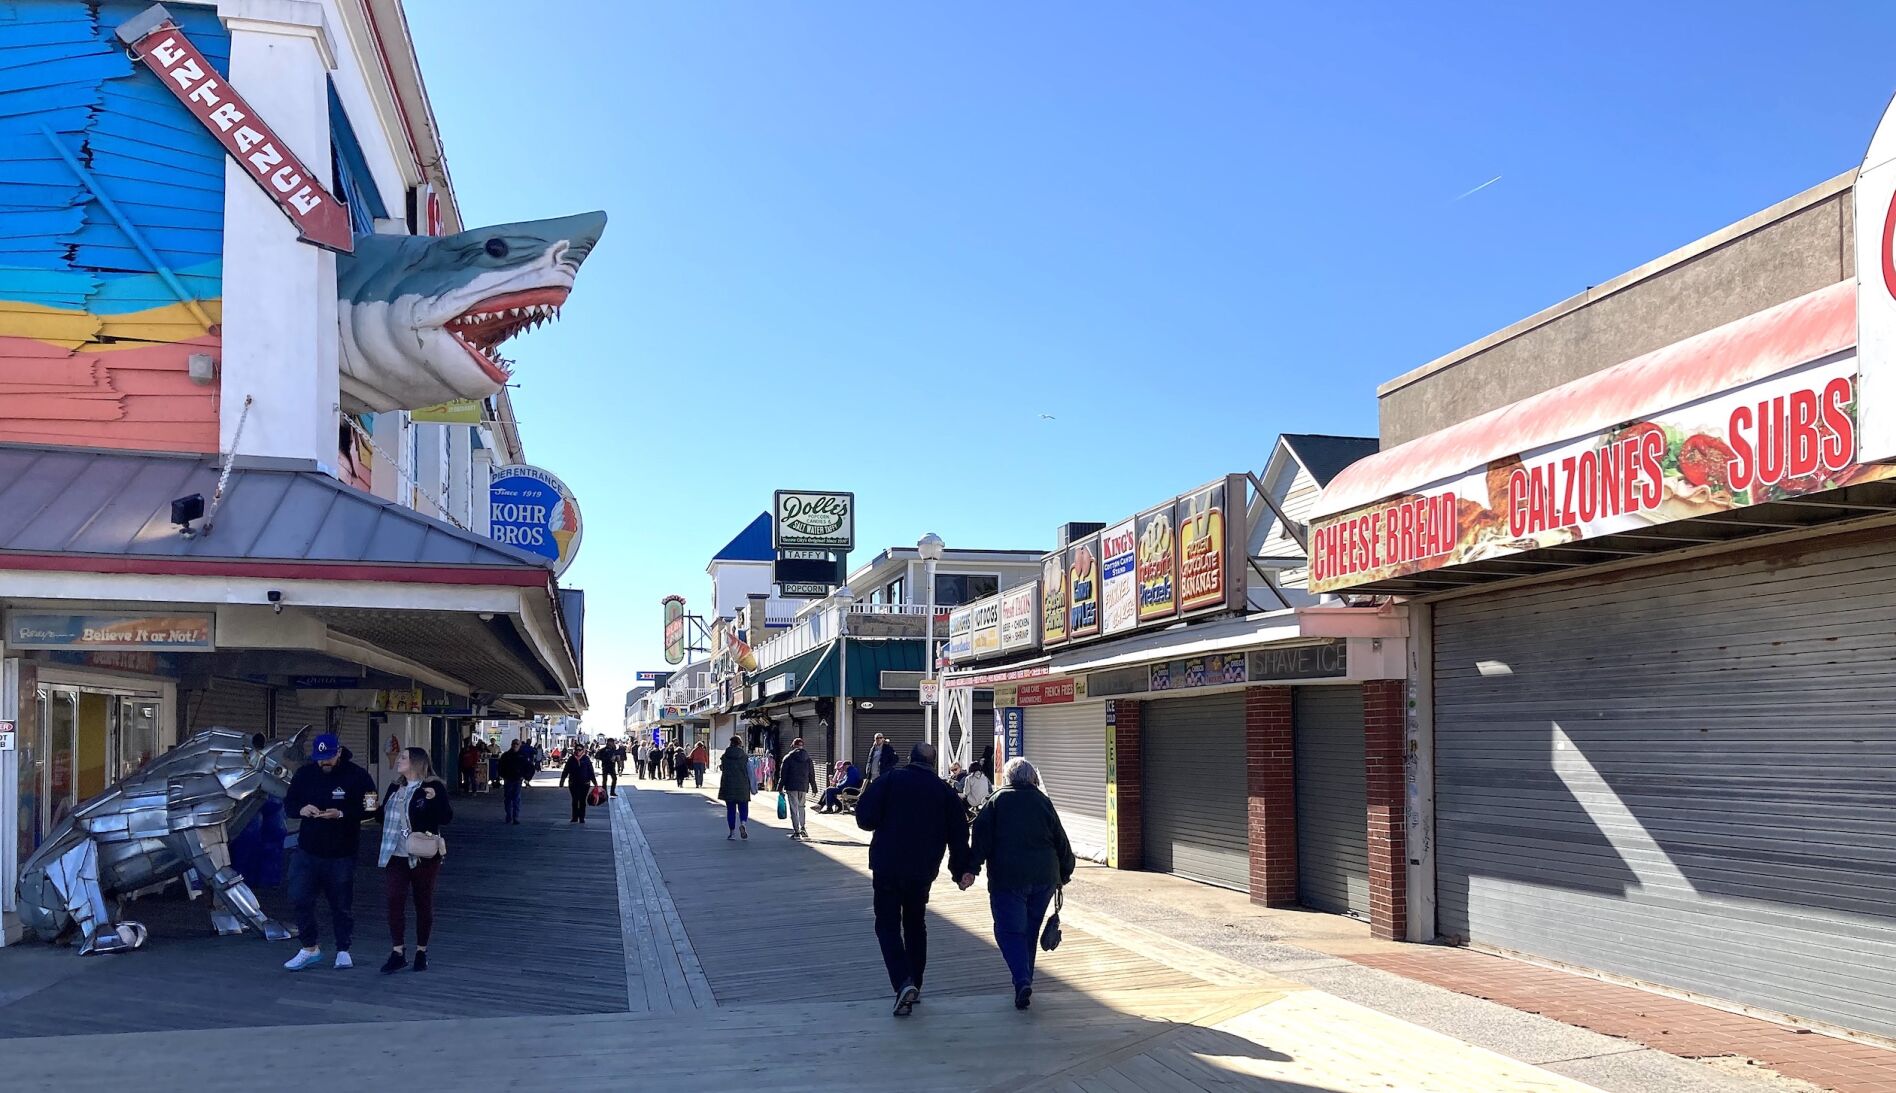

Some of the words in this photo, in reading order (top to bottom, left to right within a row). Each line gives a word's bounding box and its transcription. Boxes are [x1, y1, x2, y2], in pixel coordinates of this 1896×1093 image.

[150, 37, 322, 216] ENTRANCE
[491, 469, 513, 482] PIER
[513, 468, 564, 496] ENTRANCE
[1313, 512, 1382, 582] CHEESE
[1386, 492, 1458, 566] BREAD
[1509, 430, 1667, 538] CALZONES
[1728, 377, 1855, 492] SUBS
[494, 488, 518, 497] Since
[522, 490, 542, 498] 1919
[490, 503, 546, 525] KOHR
[781, 496, 848, 523] Dolle's
[792, 519, 806, 531] SALT
[806, 524, 825, 534] WATER
[824, 524, 838, 533] TAFFY
[788, 551, 822, 559] TAFFY
[1112, 566, 1126, 577] STAND
[786, 585, 823, 594] POPCORN
[1182, 570, 1219, 599] BANANAS
[983, 604, 998, 626] DOGS
[1014, 617, 1030, 630] CHICKEN
[82, 628, 132, 642] Believe
[134, 629, 148, 643] It
[151, 631, 166, 643] or
[167, 630, 198, 645] Not!
[1014, 629, 1029, 642] SHRIMP
[1255, 648, 1312, 675] SHAVE
[1315, 643, 1346, 672] ICE
[1044, 686, 1060, 698] FRENCH
[1061, 684, 1074, 696] FRIES
[1106, 700, 1116, 713] ICE
